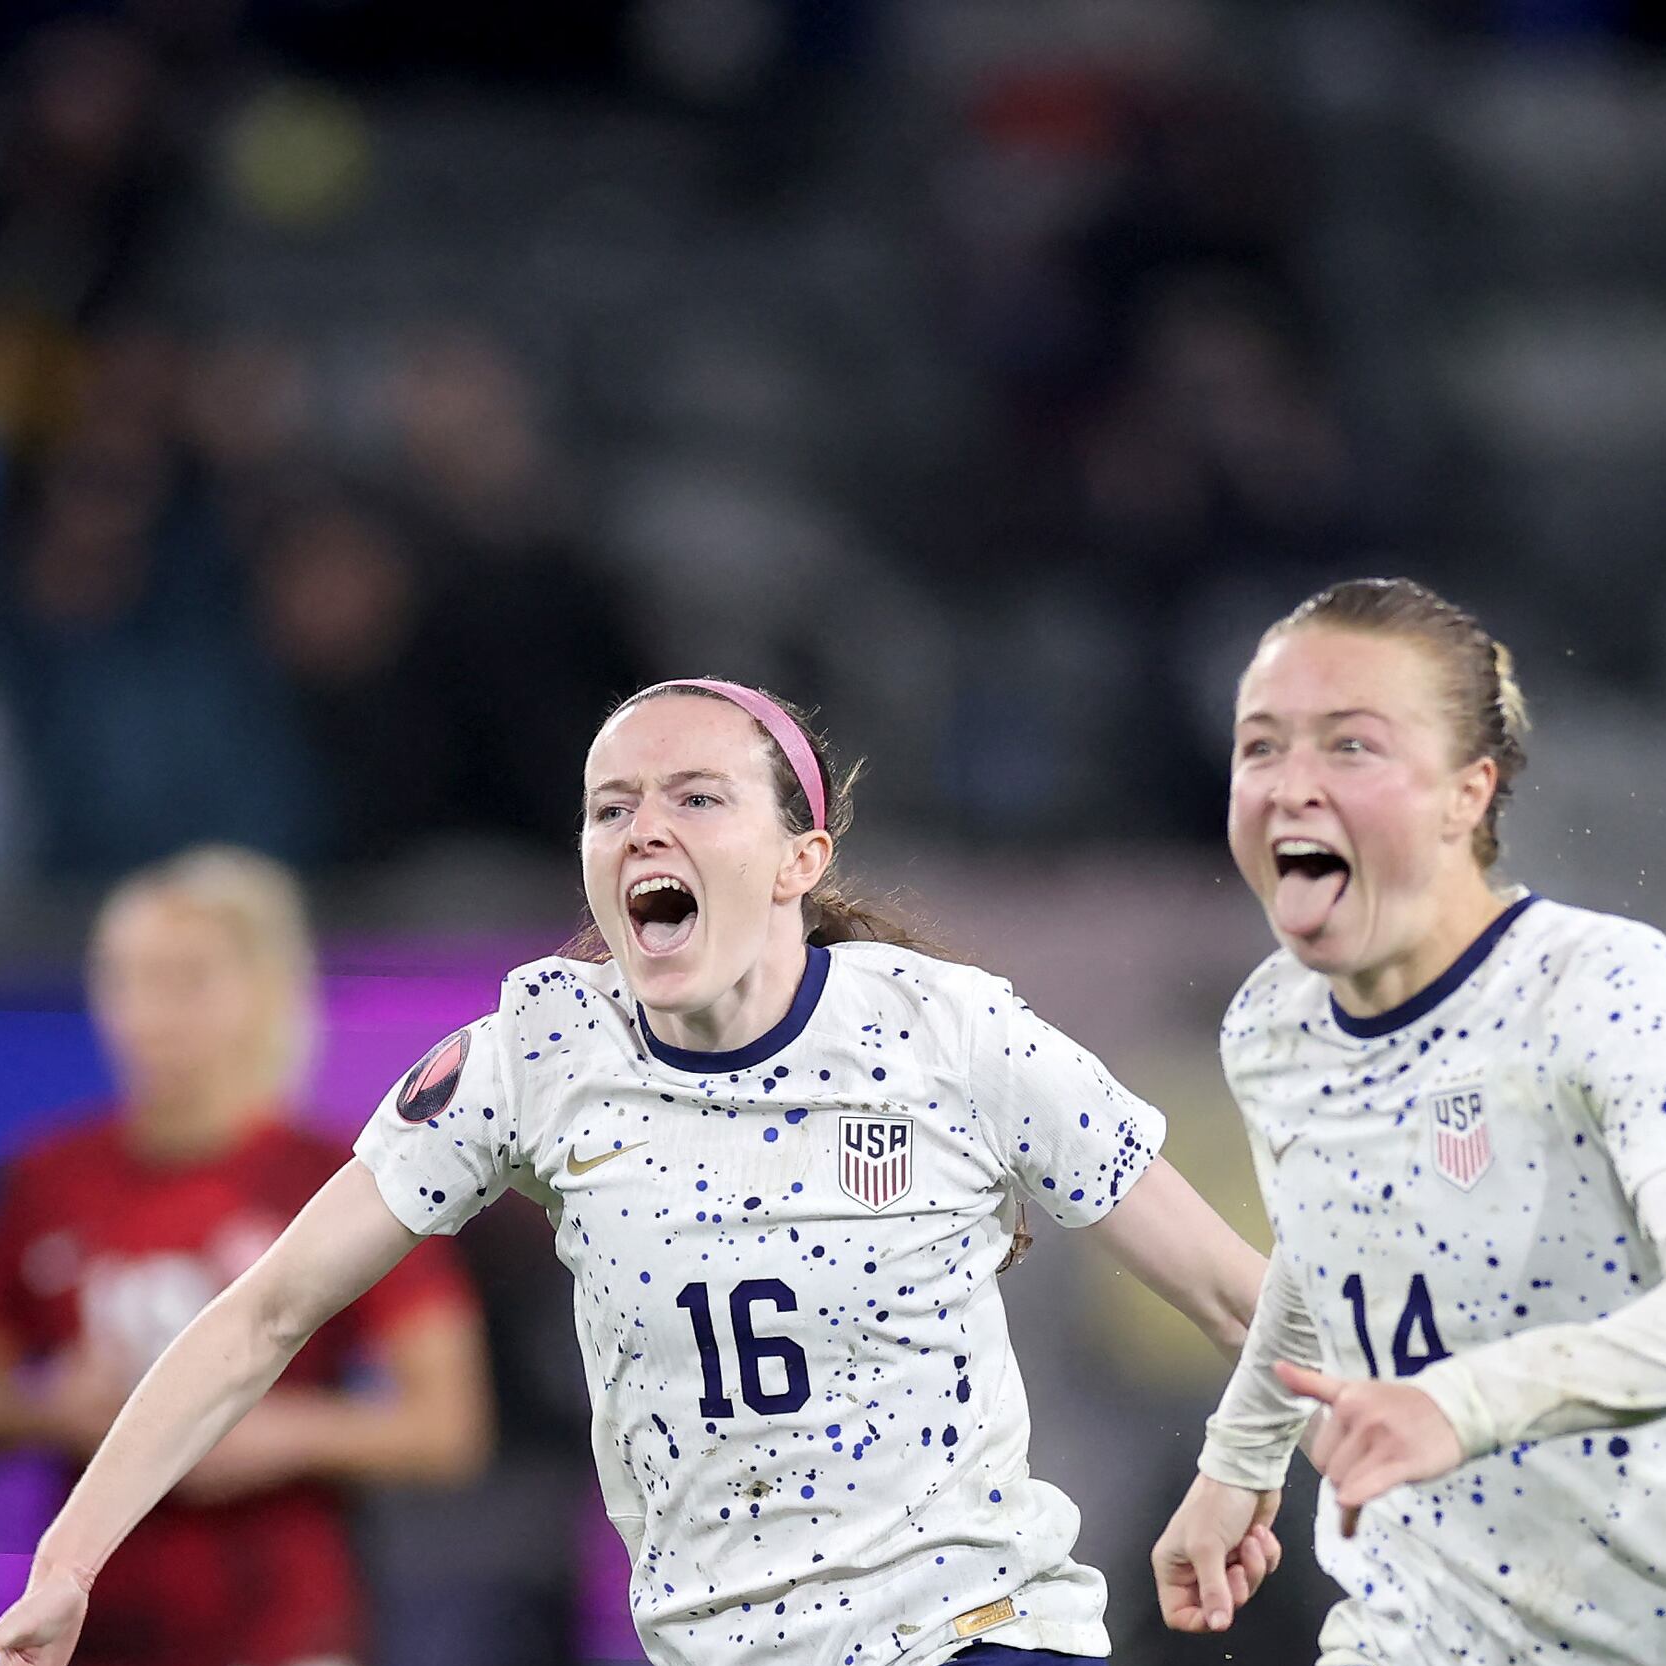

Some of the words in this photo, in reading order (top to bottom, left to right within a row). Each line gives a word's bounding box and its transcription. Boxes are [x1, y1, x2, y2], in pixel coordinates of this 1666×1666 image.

[845, 1123, 907, 1159] USA
[1435, 1092, 1481, 1131] USA
[676, 1278, 811, 1418] 16
[1342, 1272, 1454, 1379] 14
